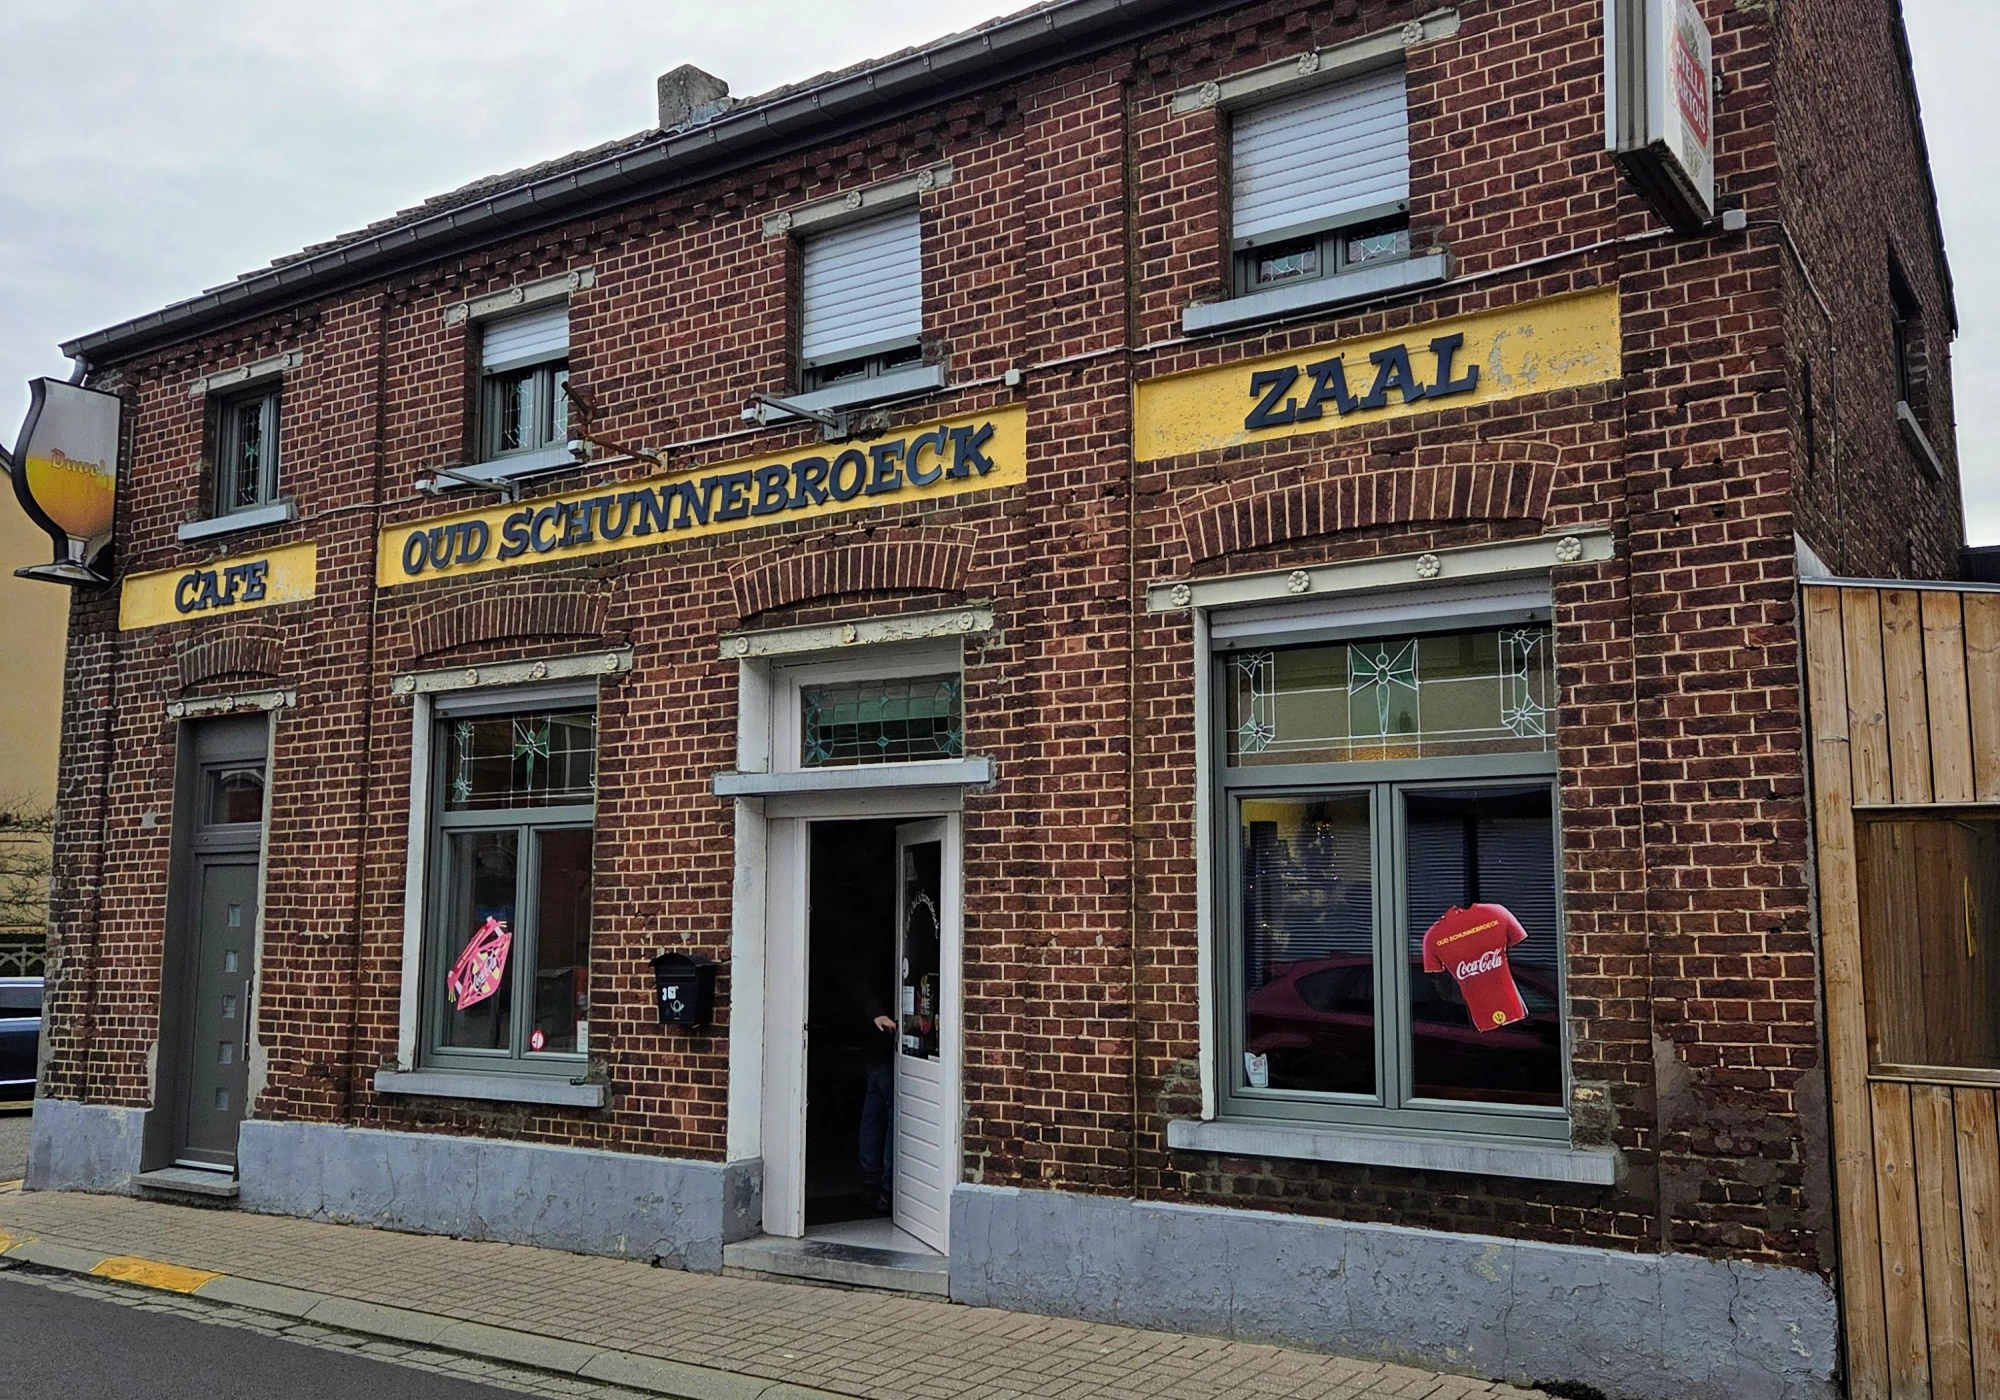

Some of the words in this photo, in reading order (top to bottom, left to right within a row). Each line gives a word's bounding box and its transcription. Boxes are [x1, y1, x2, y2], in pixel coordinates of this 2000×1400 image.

[1675, 40, 1705, 106] STELLA
[1676, 73, 1706, 134] ARTOIS
[1244, 332, 1480, 431] ZAAL
[50, 448, 106, 477] Duvel
[401, 519, 490, 575] OUD
[495, 422, 994, 561] SCHUNNEBROECK
[175, 559, 268, 613] CAFE
[1436, 938, 1449, 947] OUD
